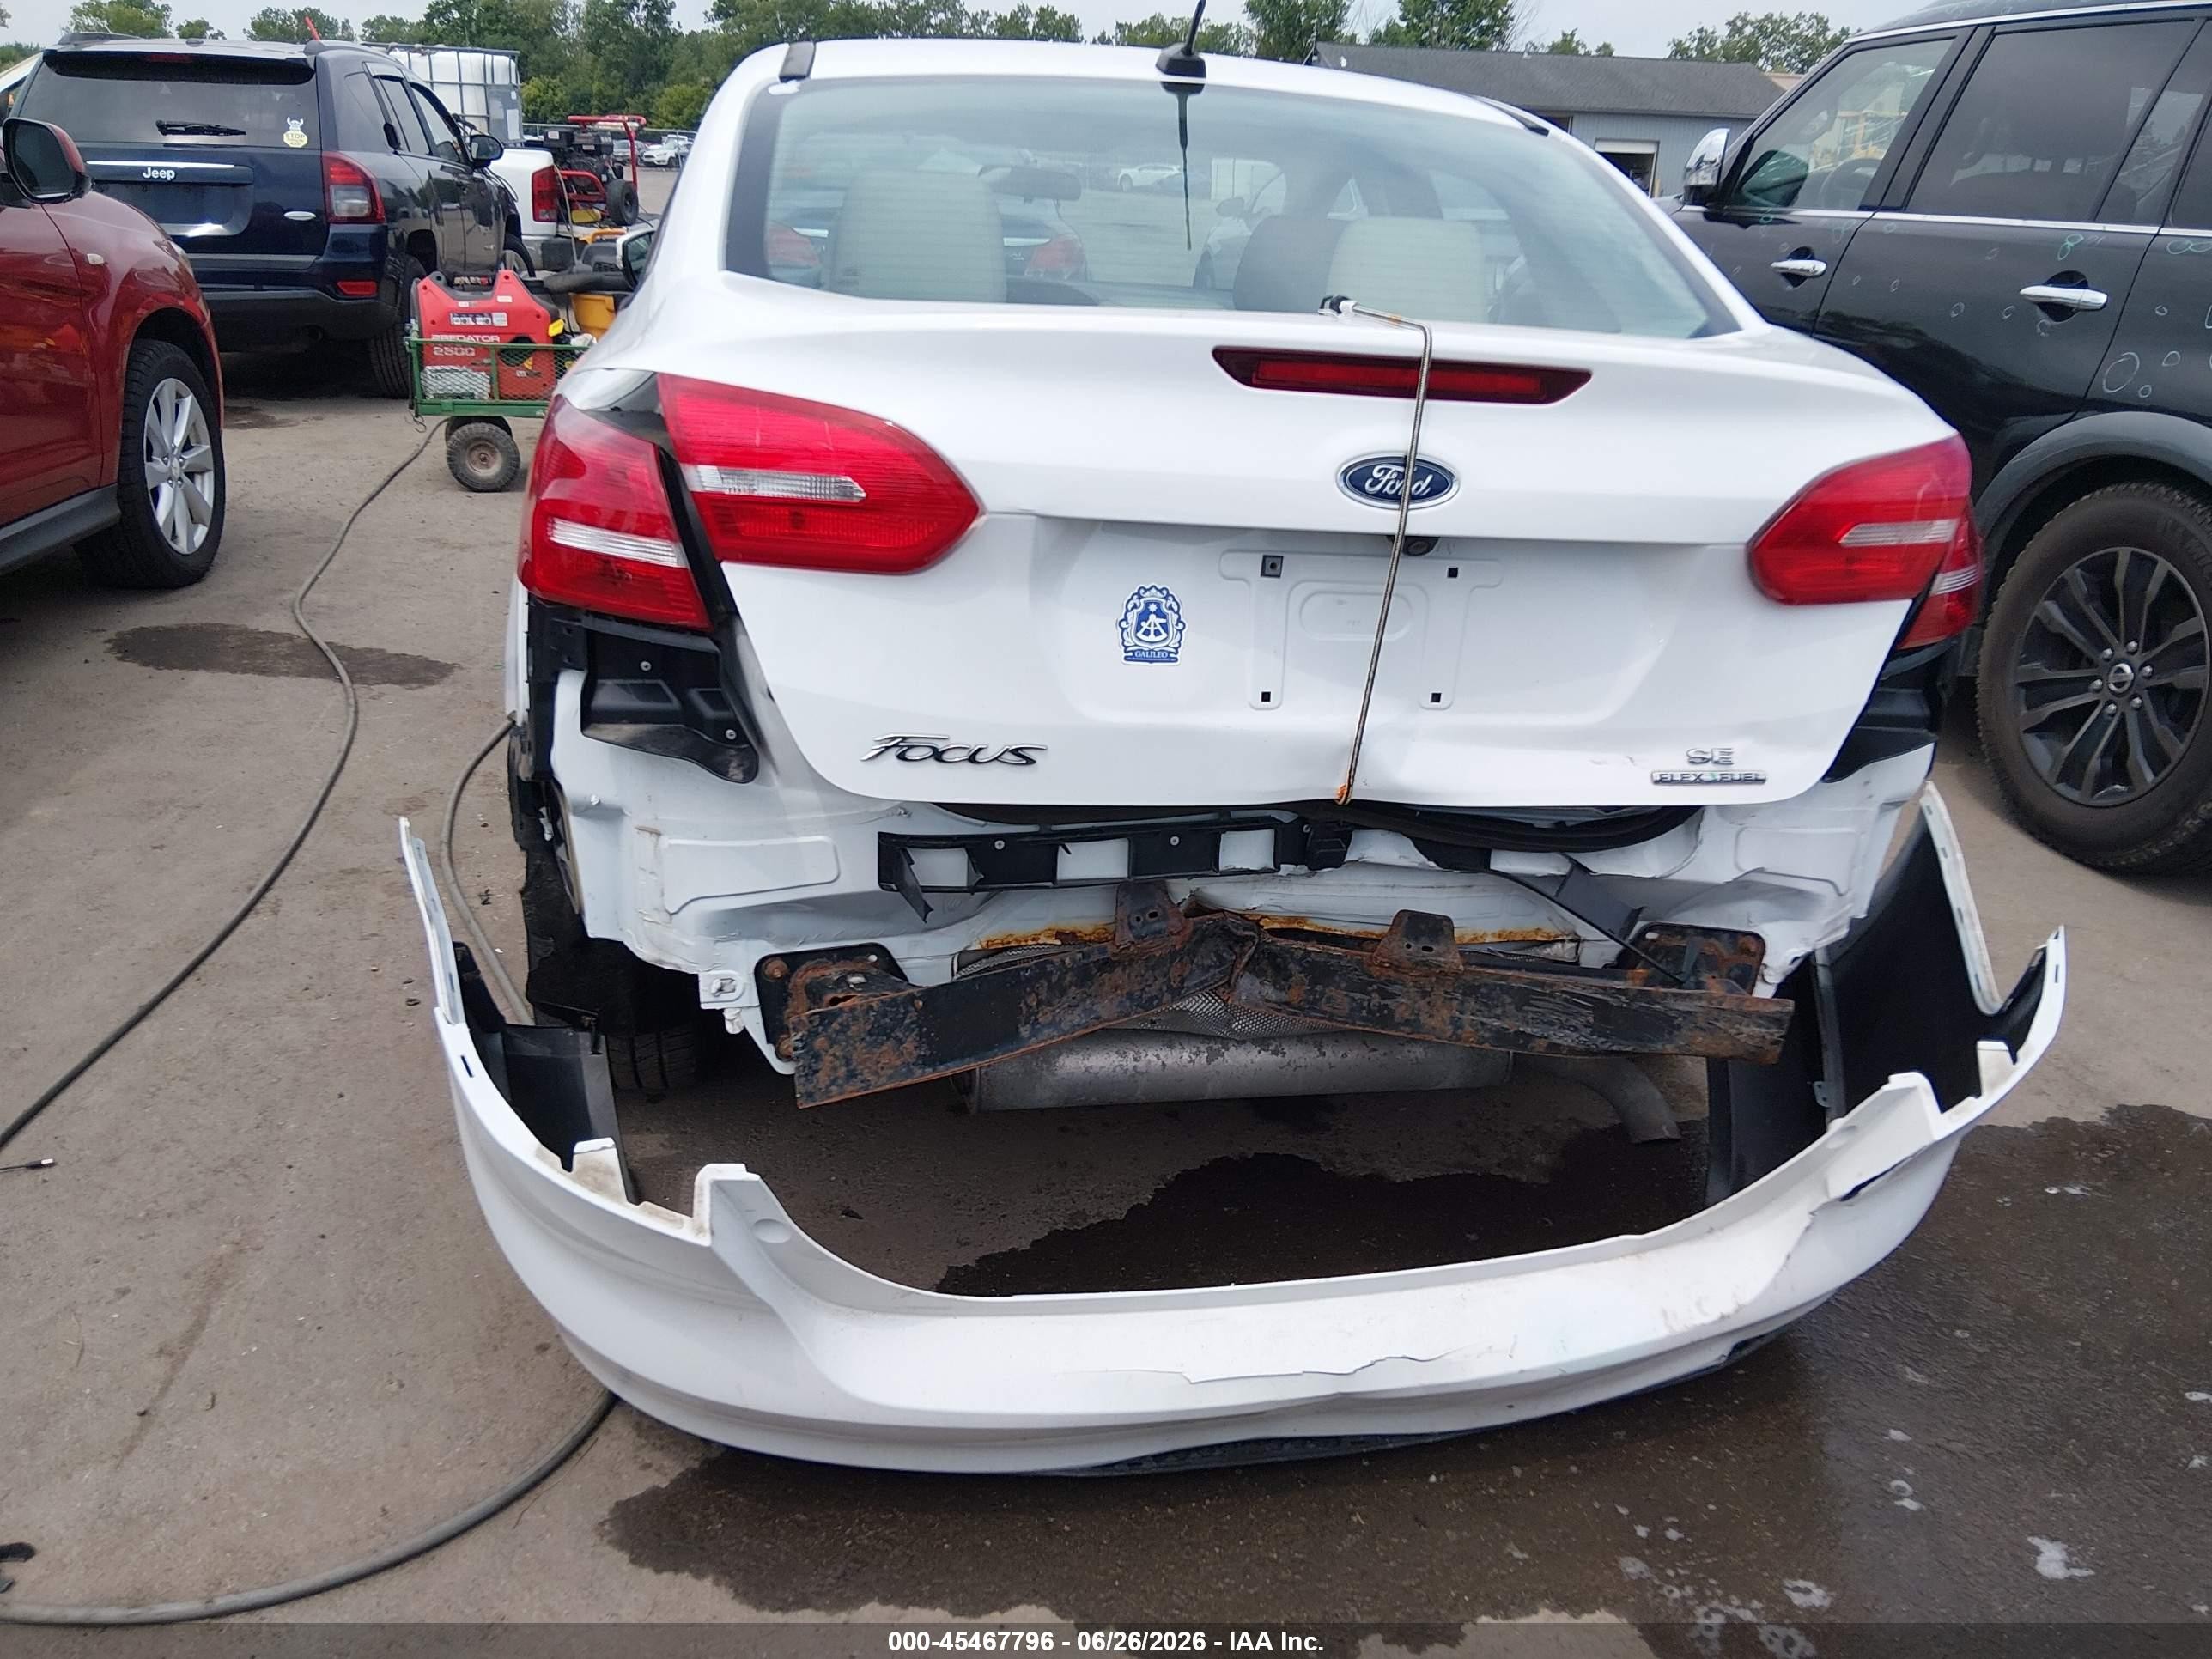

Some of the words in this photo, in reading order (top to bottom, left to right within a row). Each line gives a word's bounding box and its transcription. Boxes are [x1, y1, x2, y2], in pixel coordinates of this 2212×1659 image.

[143, 167, 175, 180] Jeep
[431, 334, 501, 343] PREDATOR
[1686, 748, 1734, 765] SE
[1658, 773, 1703, 783] FLEX
[1718, 773, 1765, 783] FUEL
